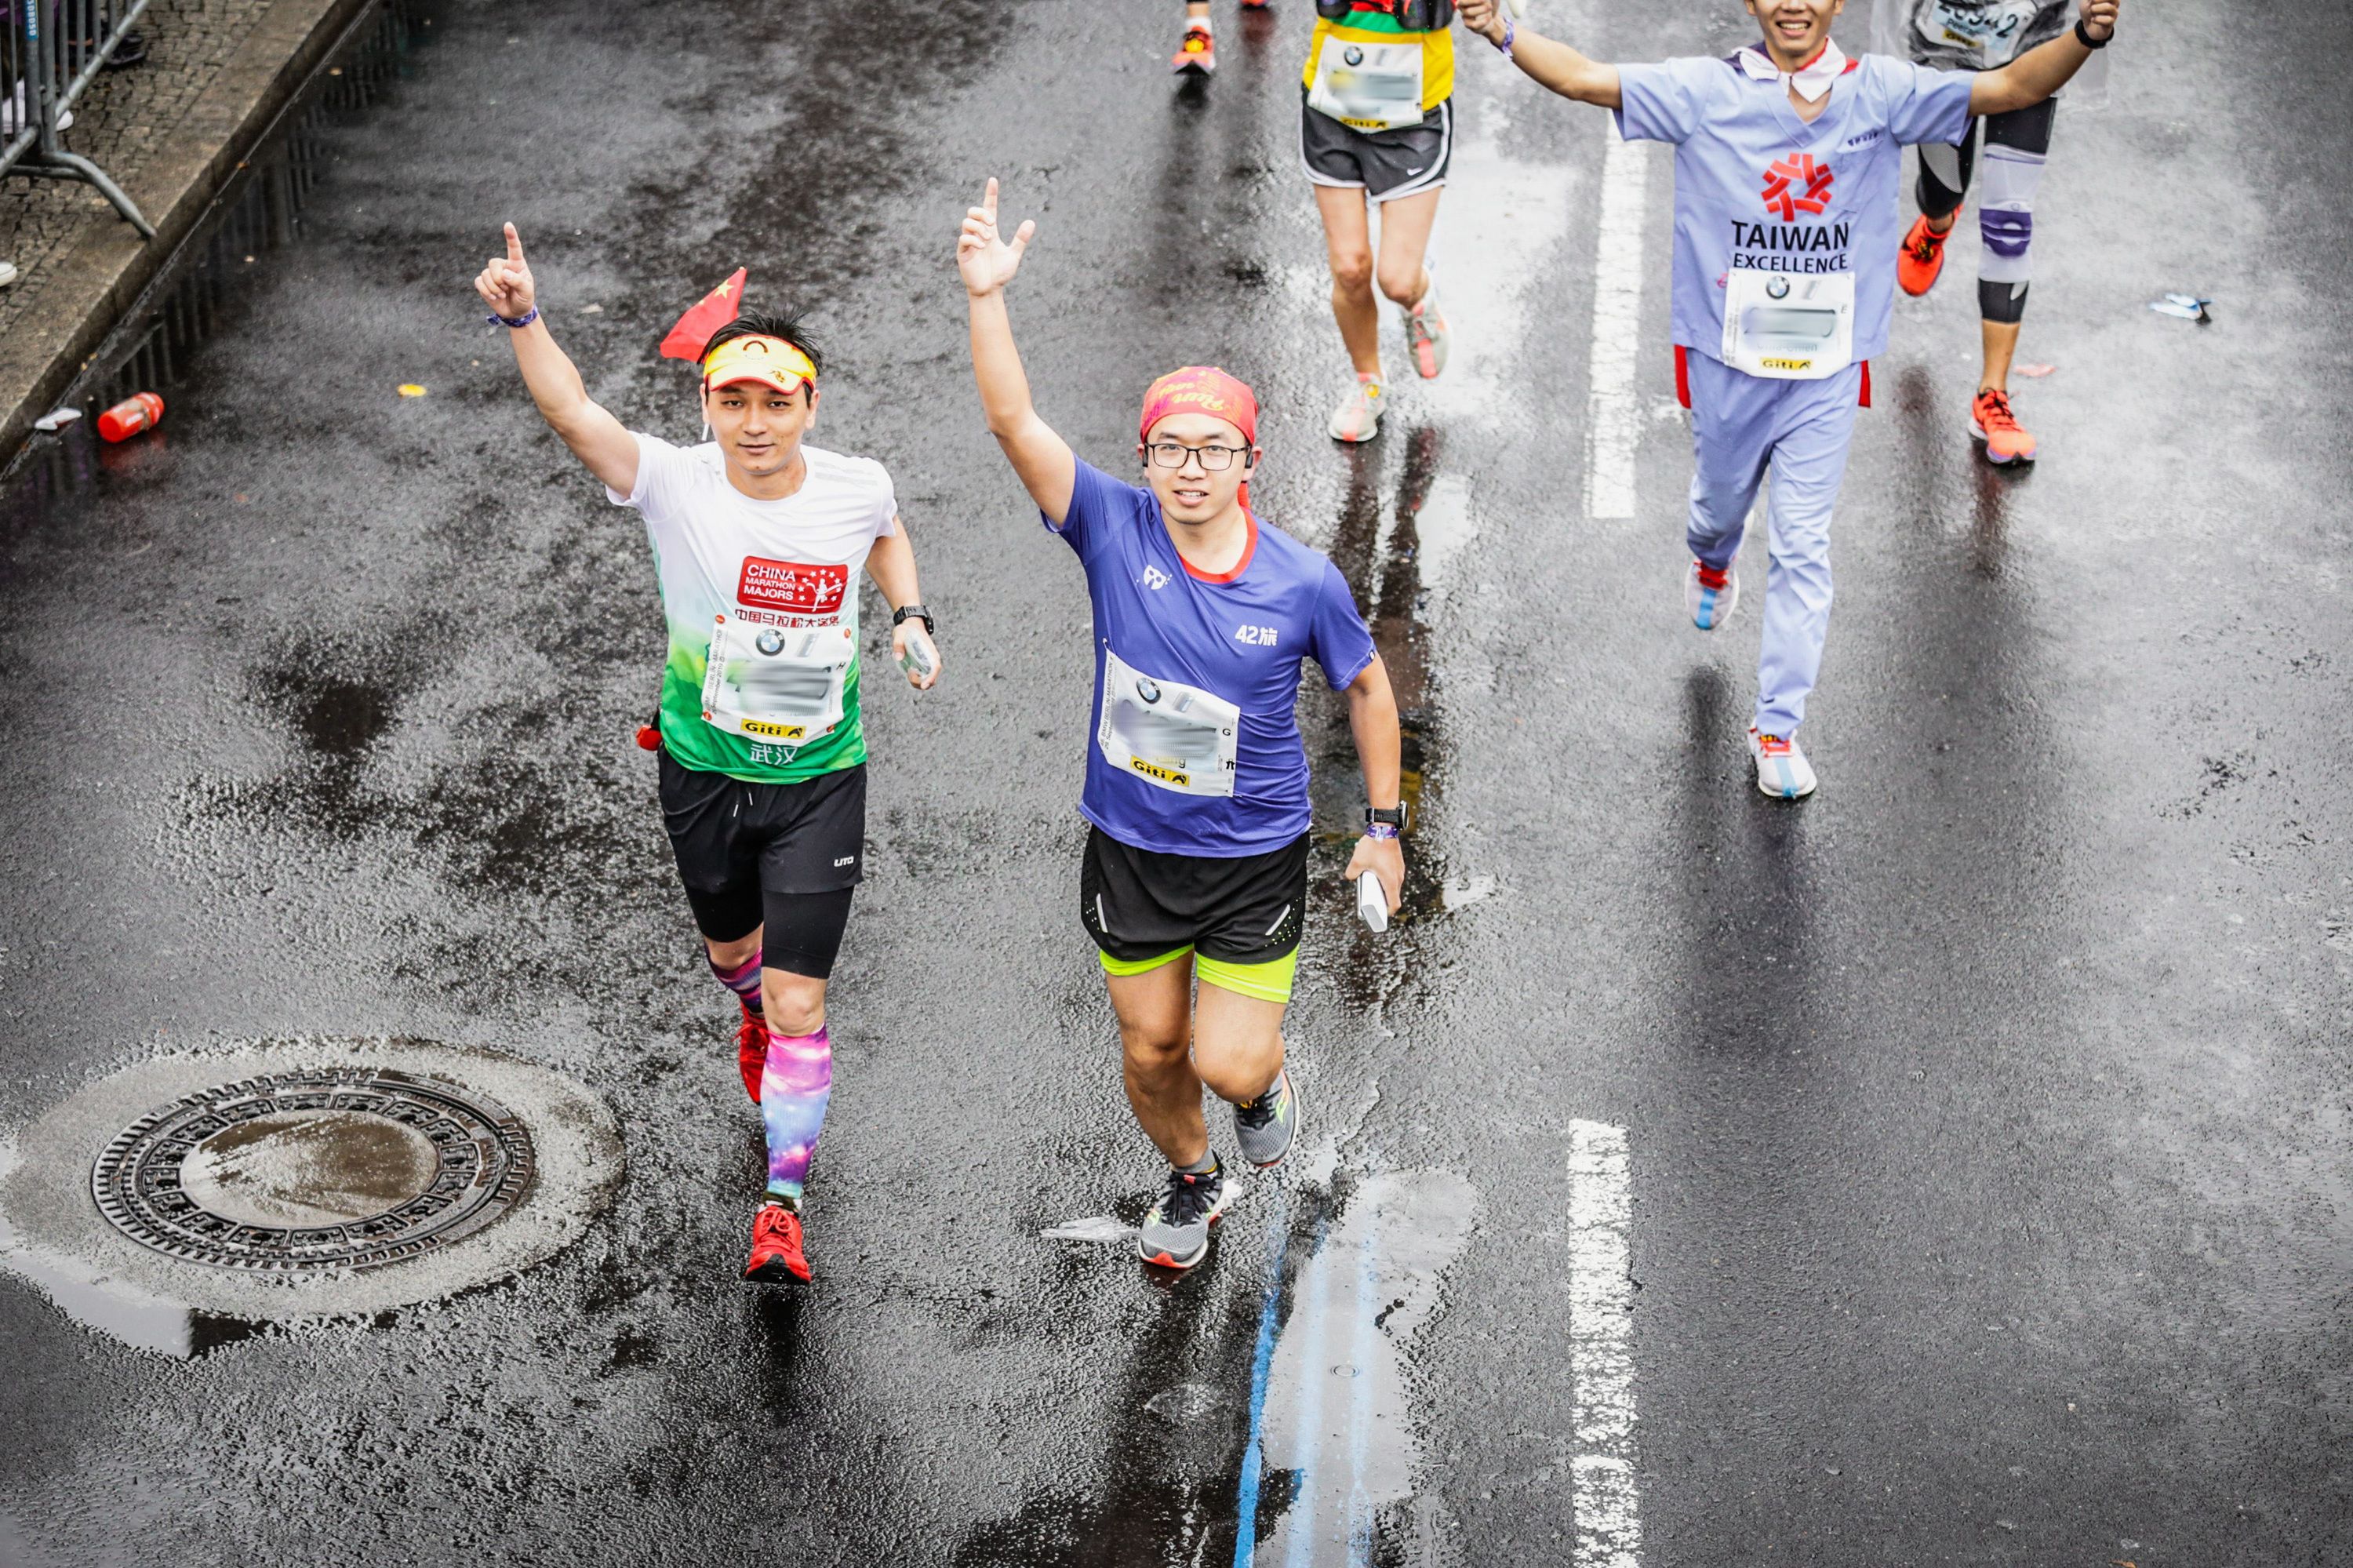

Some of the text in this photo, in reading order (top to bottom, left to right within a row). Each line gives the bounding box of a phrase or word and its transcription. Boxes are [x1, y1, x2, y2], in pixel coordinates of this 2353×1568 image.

[1731, 220, 1849, 252] TAIWAN
[1733, 253, 1848, 274] EXCELLENCE
[1763, 359, 1793, 369] Giti
[747, 564, 796, 582] CHINA
[745, 577, 795, 591] MARATHON
[744, 585, 794, 601] MAJORS
[745, 722, 781, 735] Giti
[1223, 728, 1231, 737] G
[750, 744, 798, 766] 武汉
[1133, 761, 1166, 779] Giti
[834, 856, 854, 867] UTO
